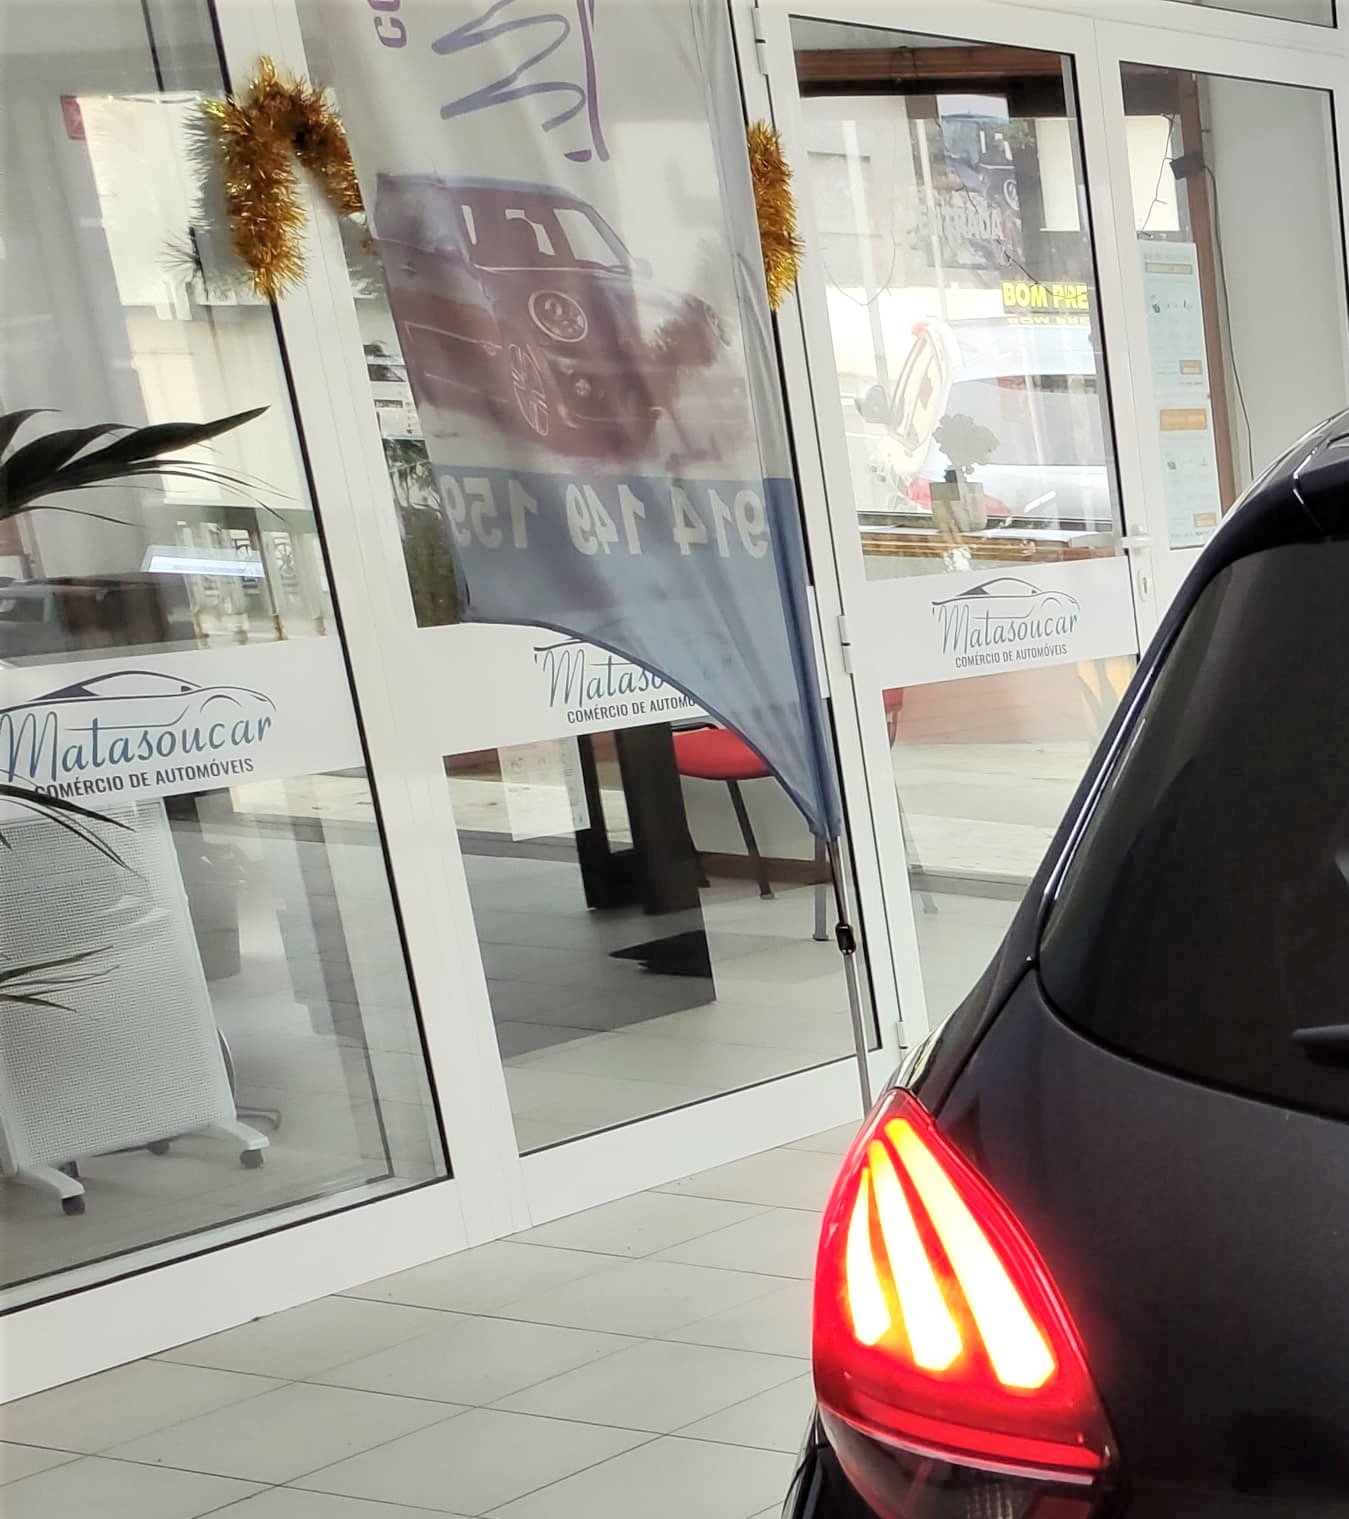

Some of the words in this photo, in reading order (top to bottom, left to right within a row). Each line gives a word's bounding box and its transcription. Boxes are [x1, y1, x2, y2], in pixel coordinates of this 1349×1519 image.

[1002, 282, 1048, 308] BOM
[938, 603, 1078, 655] Matasoucar
[955, 649, 1001, 668] COMÉRCIO
[1003, 651, 1014, 663] DE
[1016, 643, 1068, 661] AUTOMÓVEIS
[567, 704, 629, 724] COMÉRCIO
[632, 702, 646, 715] DE
[0, 711, 272, 784] Matasoucar
[129, 772, 149, 788] DE
[156, 757, 255, 785] AUTOMÓVEIS
